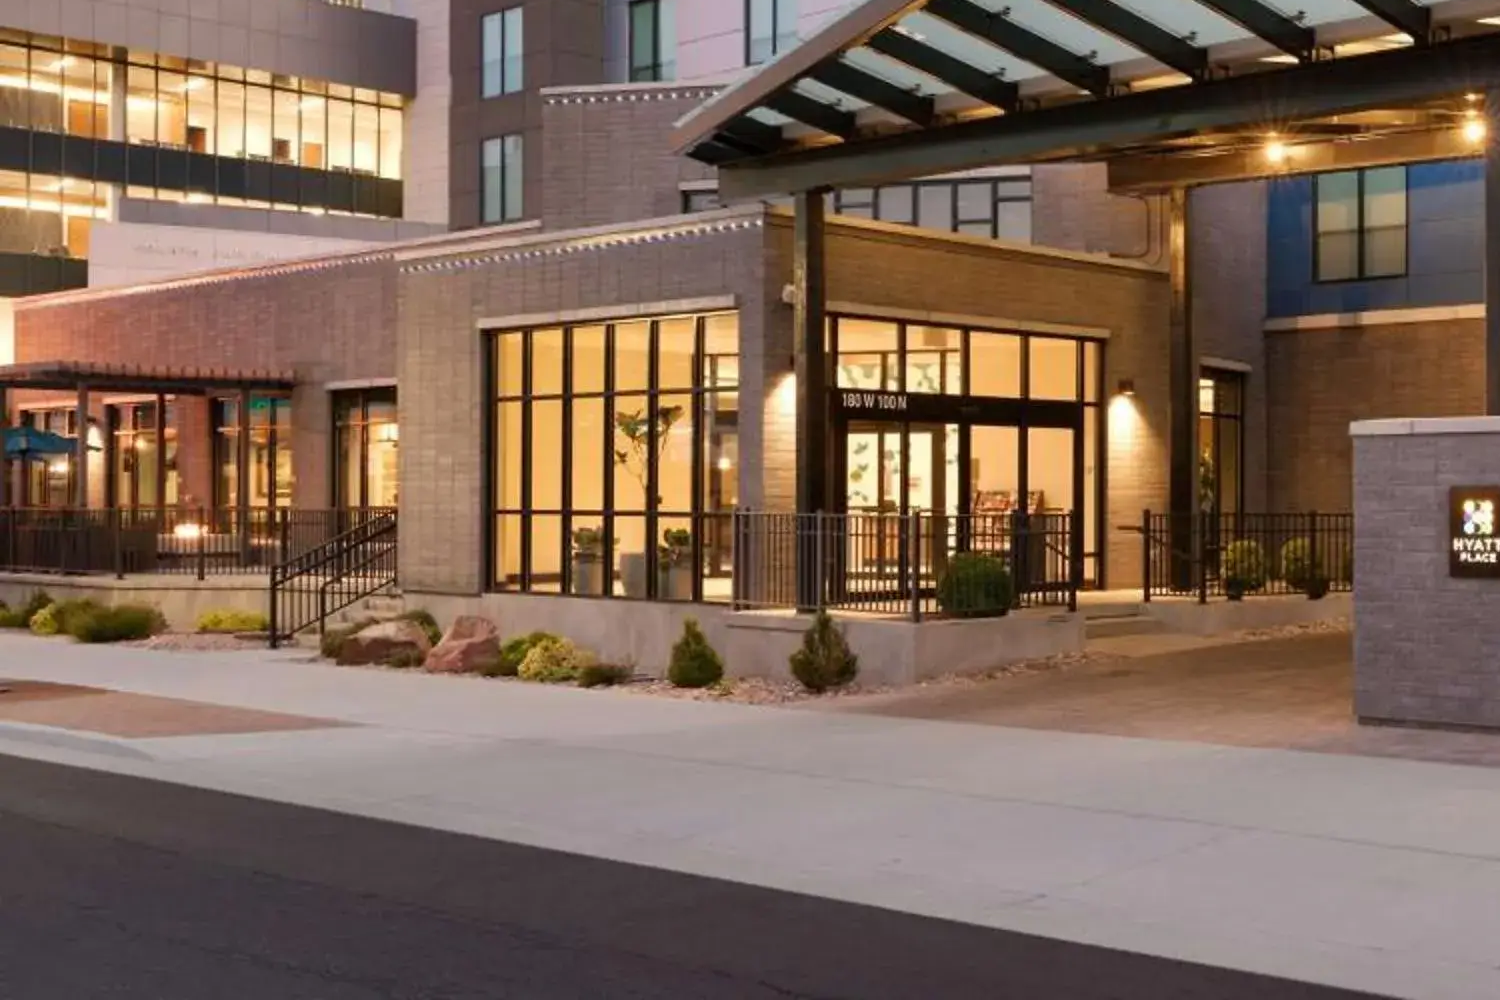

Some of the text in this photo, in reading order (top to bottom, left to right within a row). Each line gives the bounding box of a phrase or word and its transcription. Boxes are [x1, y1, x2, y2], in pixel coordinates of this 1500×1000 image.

[864, 393, 875, 409] W
[877, 395, 897, 409] 100
[897, 395, 907, 410] N
[1460, 552, 1497, 563] PLACE
